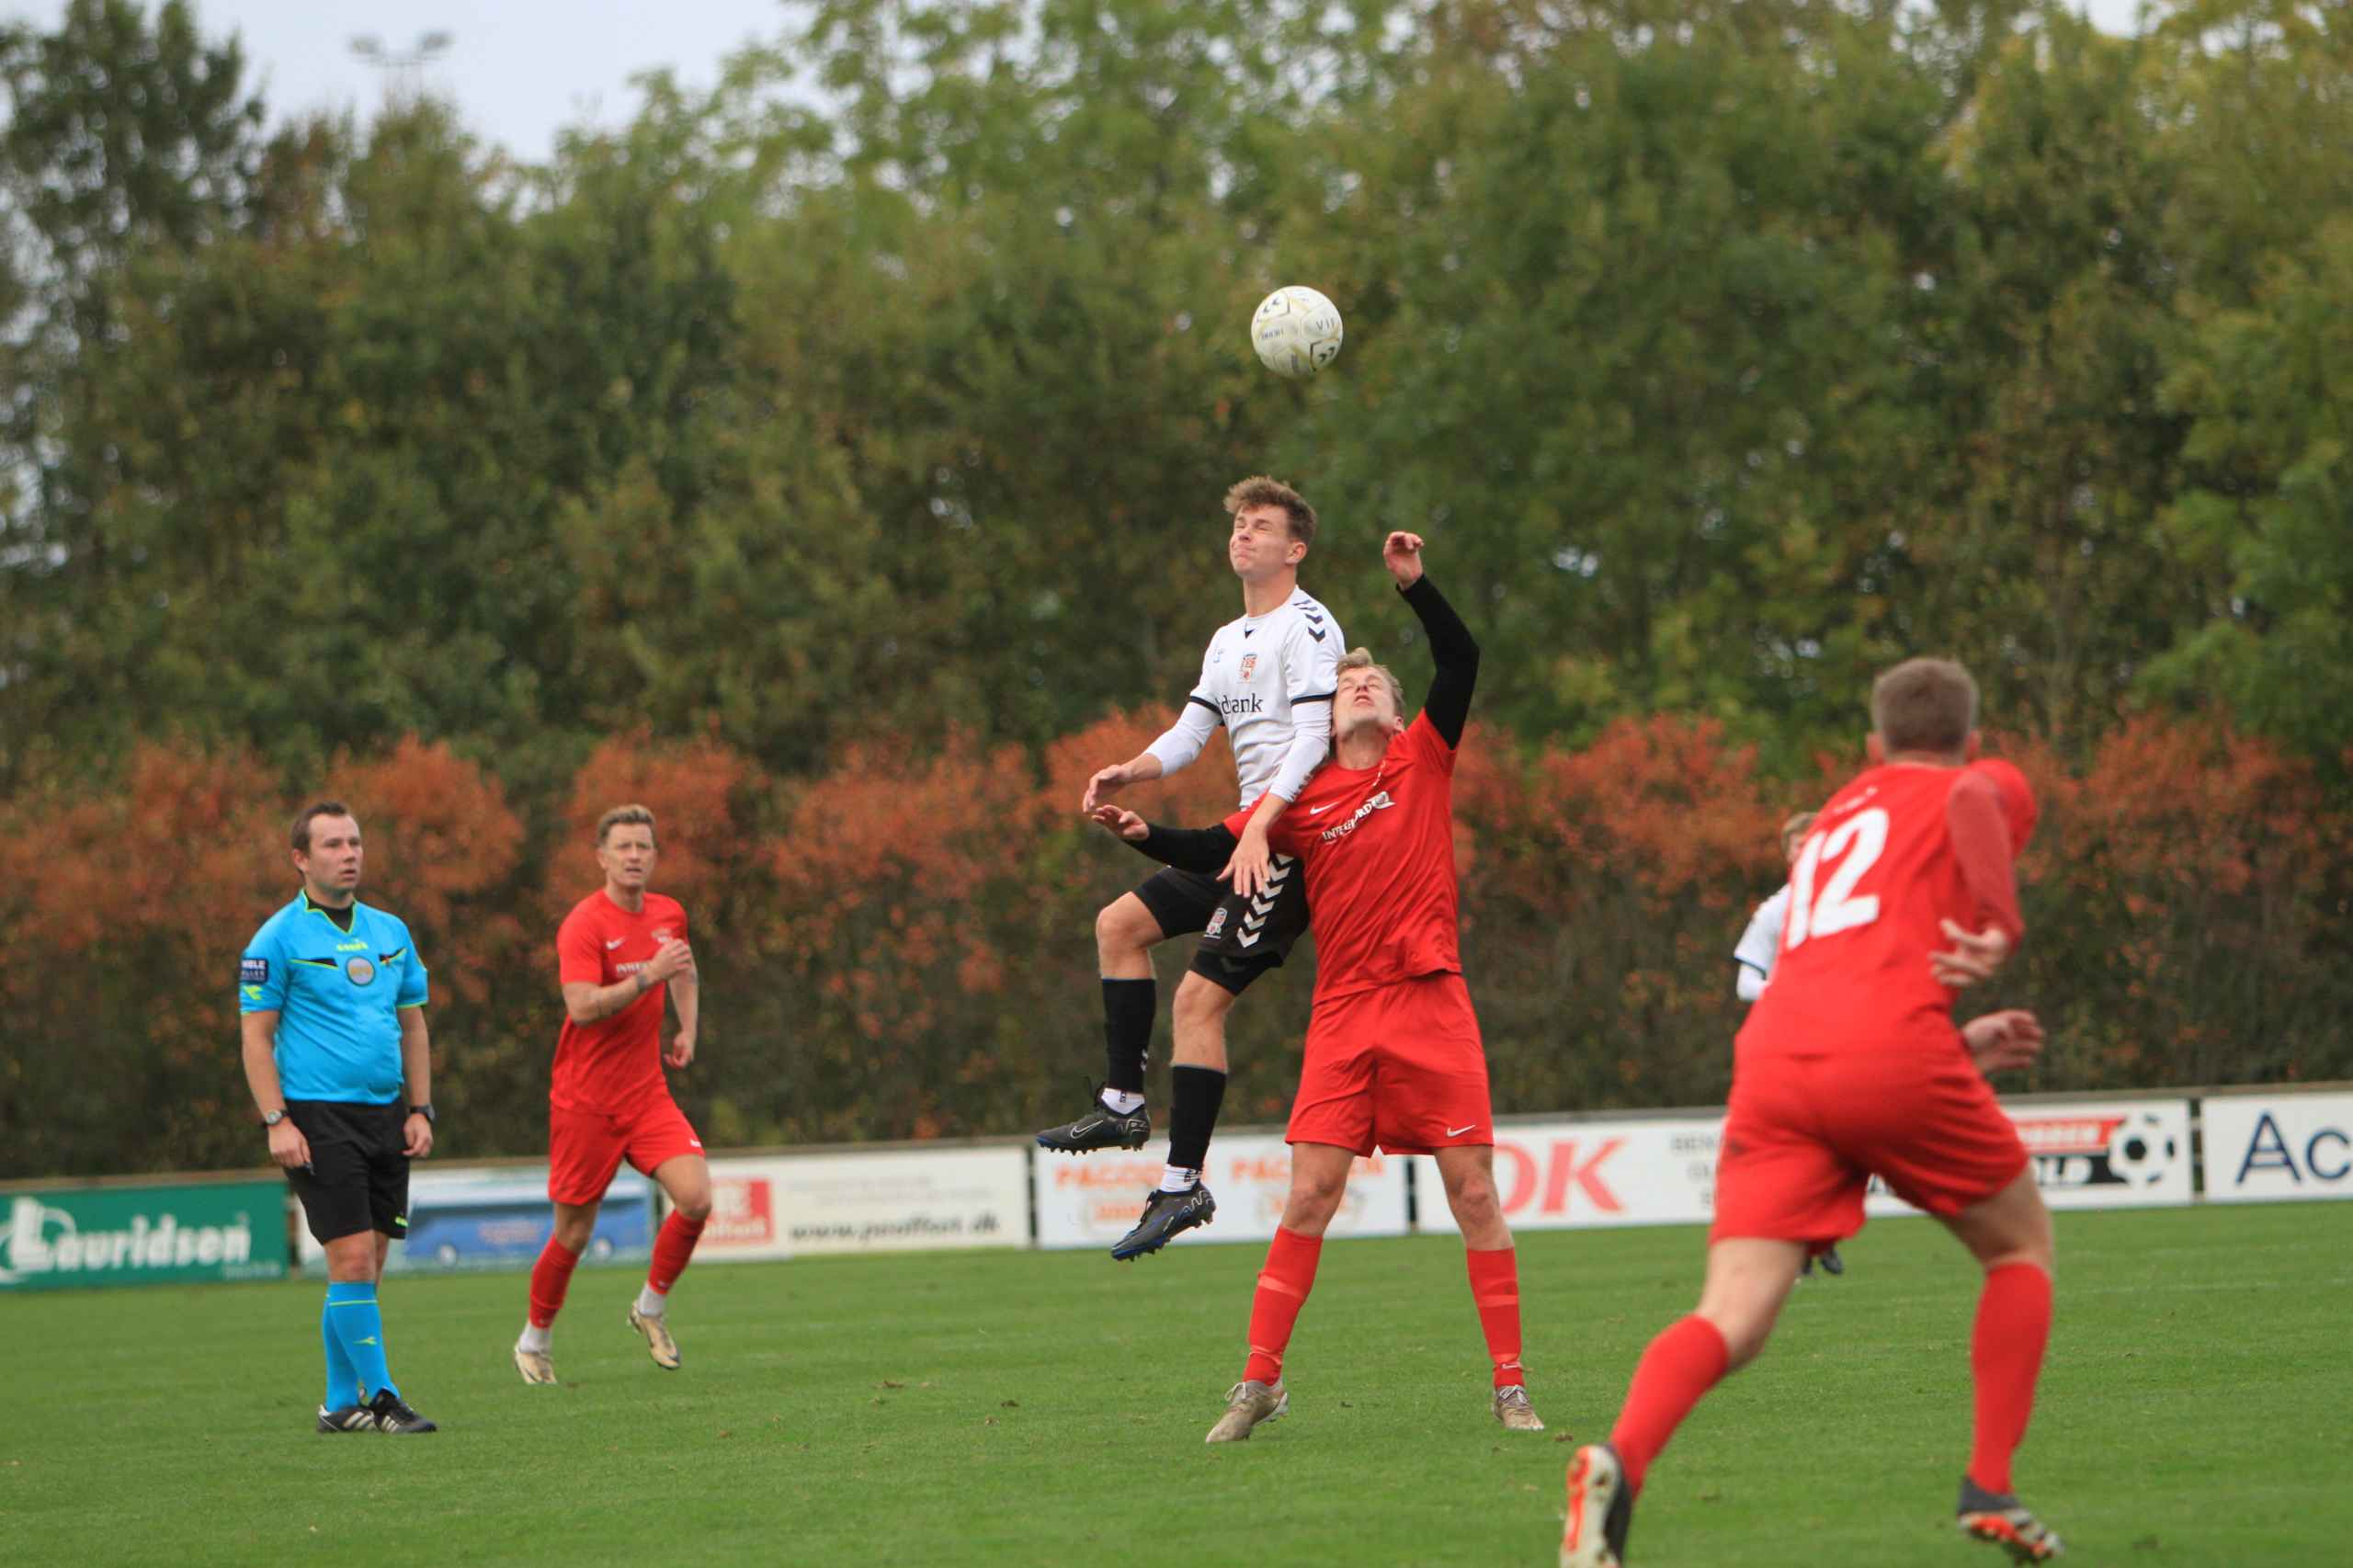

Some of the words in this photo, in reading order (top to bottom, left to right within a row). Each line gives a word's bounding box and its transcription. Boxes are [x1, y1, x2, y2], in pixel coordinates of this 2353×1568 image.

[1787, 807, 1890, 950] 12
[2236, 1109, 2353, 1186] Ac
[0, 1196, 251, 1281] Lauridsen
